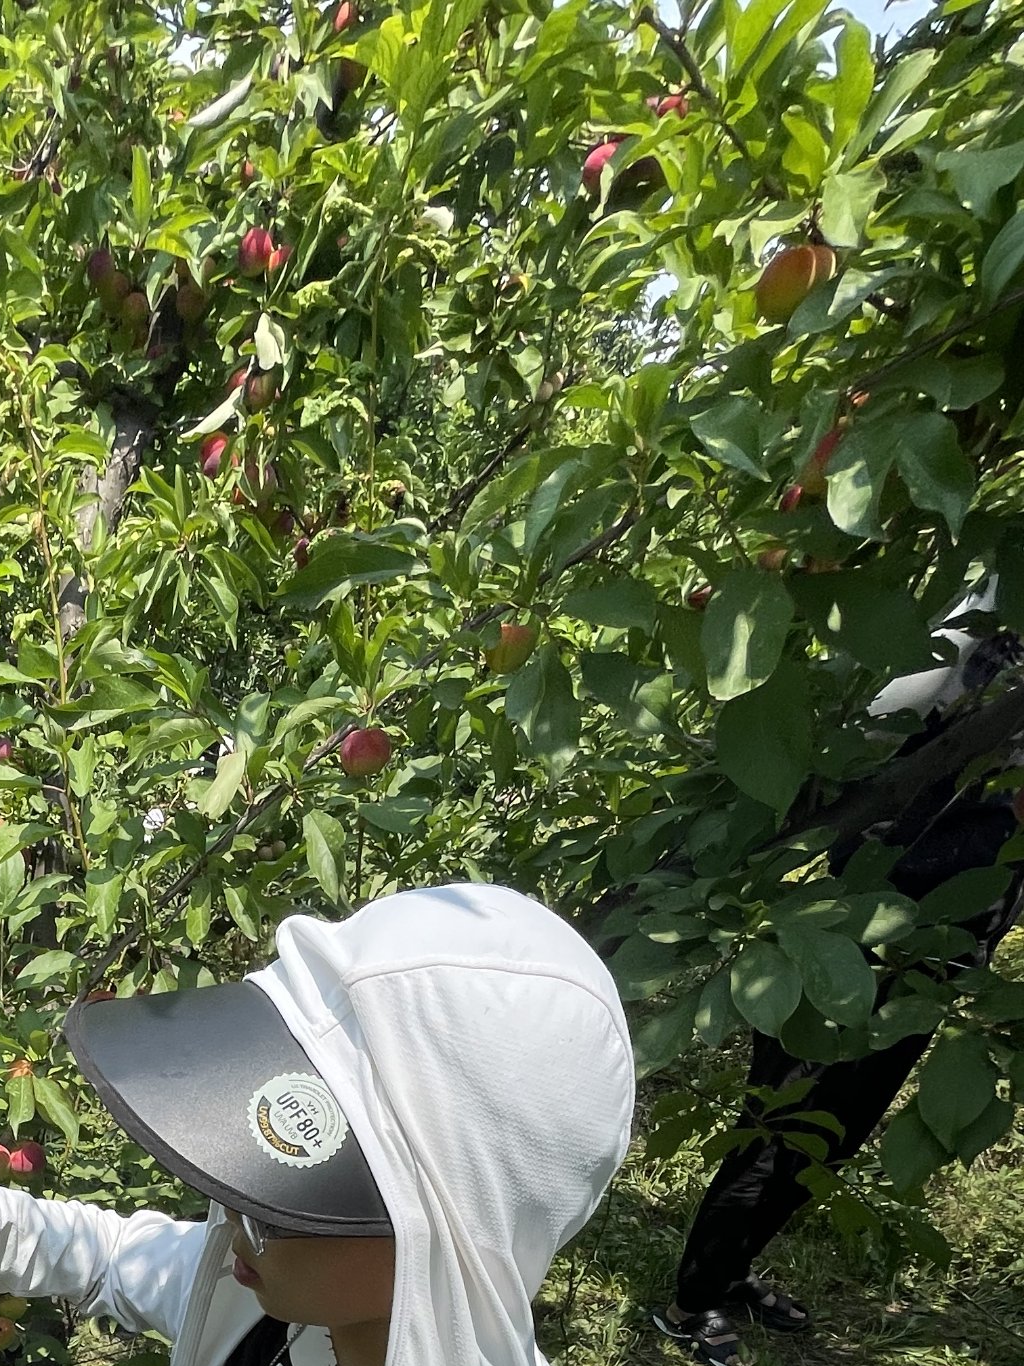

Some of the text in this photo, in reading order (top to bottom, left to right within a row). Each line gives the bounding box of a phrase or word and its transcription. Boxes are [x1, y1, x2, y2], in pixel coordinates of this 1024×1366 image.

[274, 1110, 298, 1140] UVA UVB
[276, 1091, 322, 1148] UPF80+
[325, 1100, 336, 1136] PROTECTION
